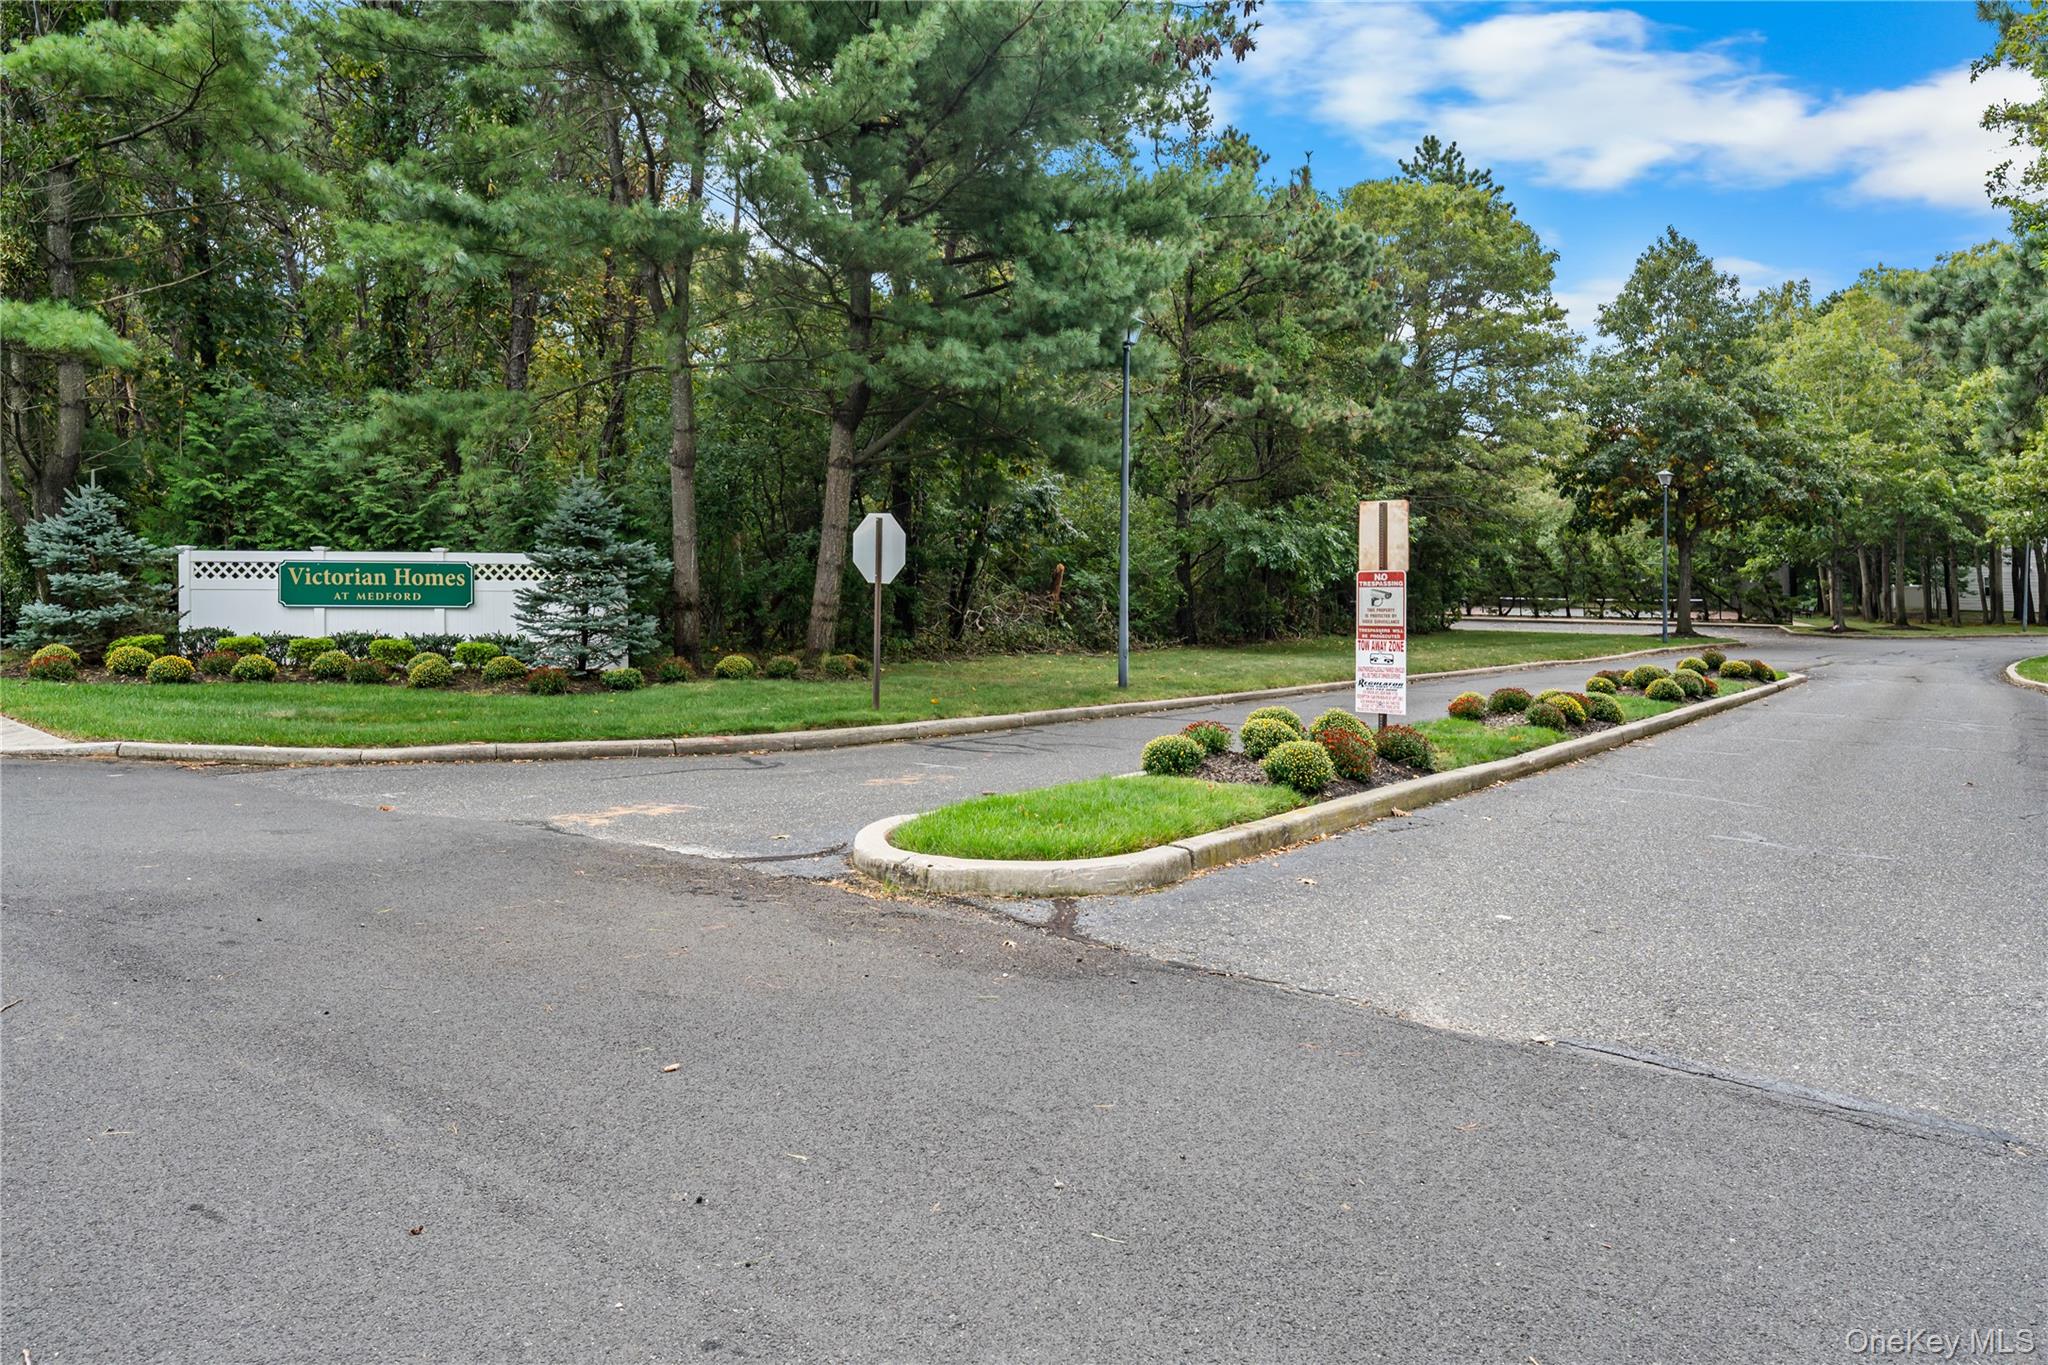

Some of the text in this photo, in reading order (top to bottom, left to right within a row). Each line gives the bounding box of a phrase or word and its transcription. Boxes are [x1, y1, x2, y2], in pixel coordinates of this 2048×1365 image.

[288, 567, 465, 586] Victorian Homes
[334, 592, 422, 601] AT MEDFORD
[1357, 640, 1404, 652] TOW AWAY ZONE
